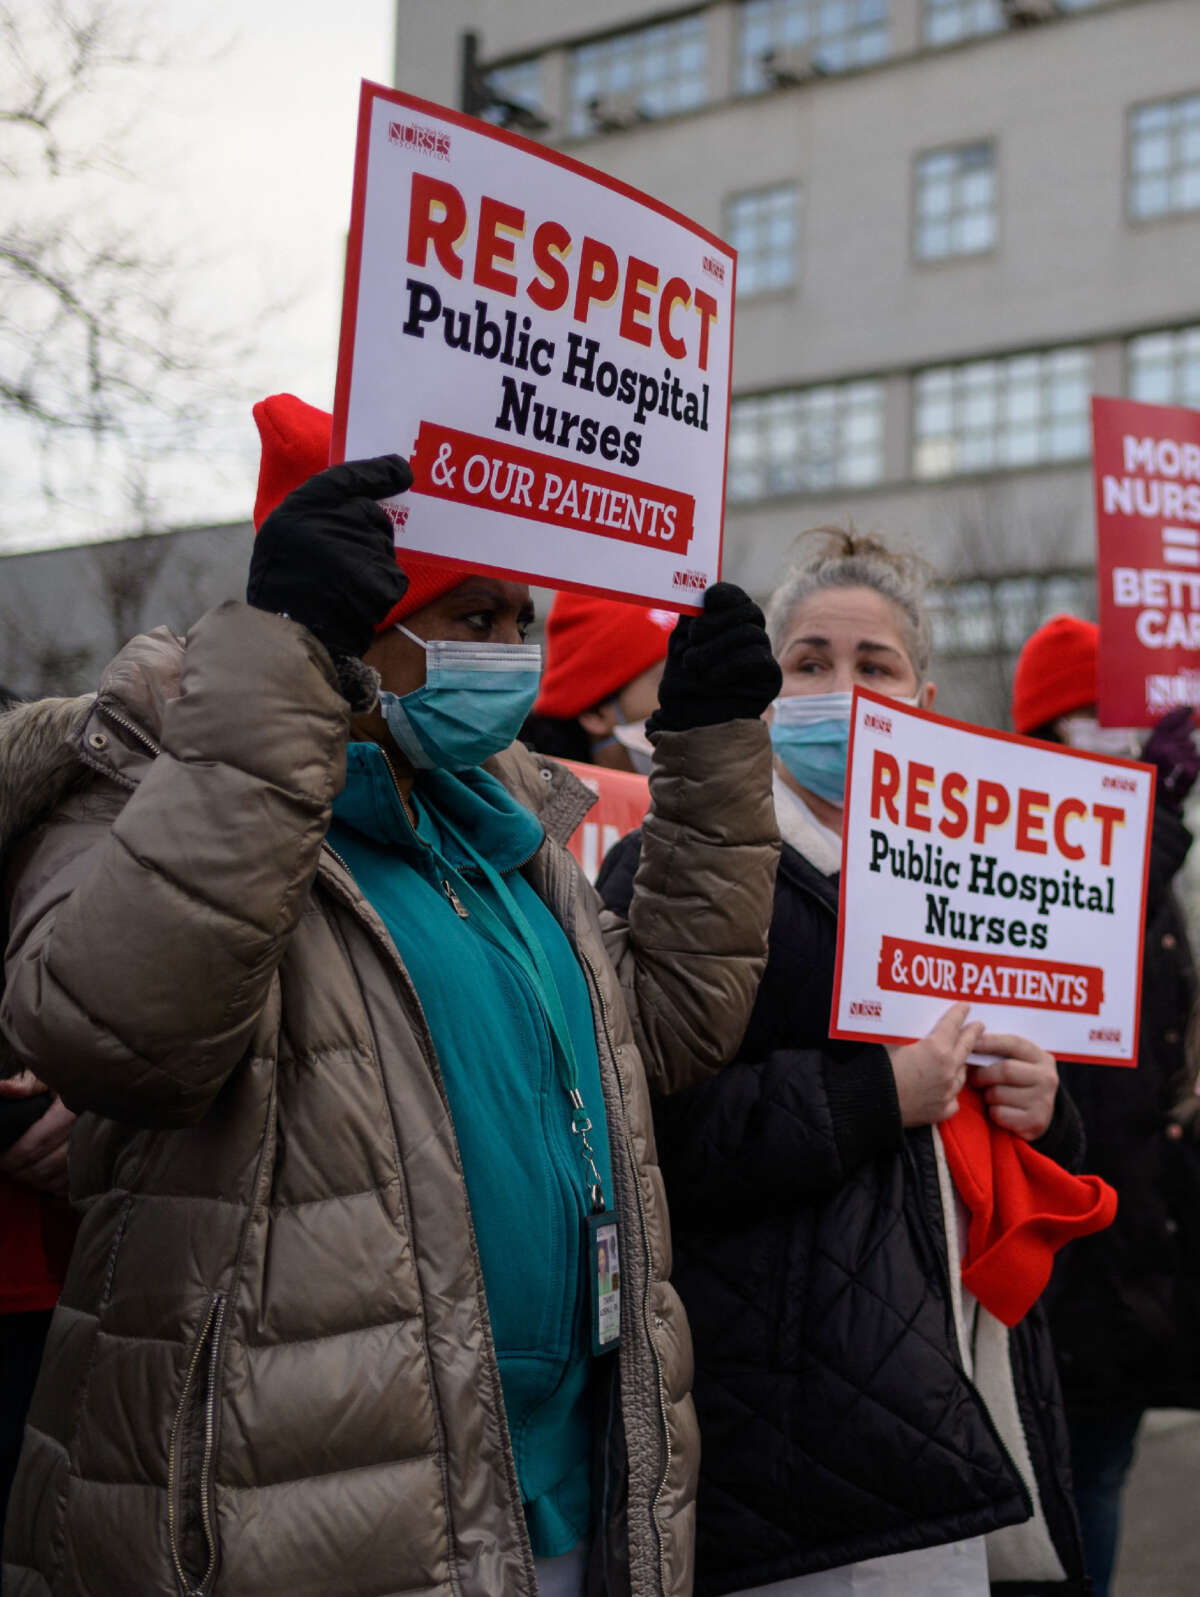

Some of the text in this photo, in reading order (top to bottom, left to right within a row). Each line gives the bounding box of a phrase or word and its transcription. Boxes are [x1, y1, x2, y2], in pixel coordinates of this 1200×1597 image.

[389, 121, 451, 155] NURSES
[406, 171, 719, 371] RESPECT
[403, 278, 709, 431] Public Hospital
[494, 375, 642, 467] Nurses
[431, 442, 678, 540] & OUR PATIENTS
[869, 748, 1127, 867] RESPECT
[869, 829, 1115, 915] Public Hospital
[925, 893, 1048, 950] Nurses
[891, 949, 1088, 1007] & OUR PATIENTS
